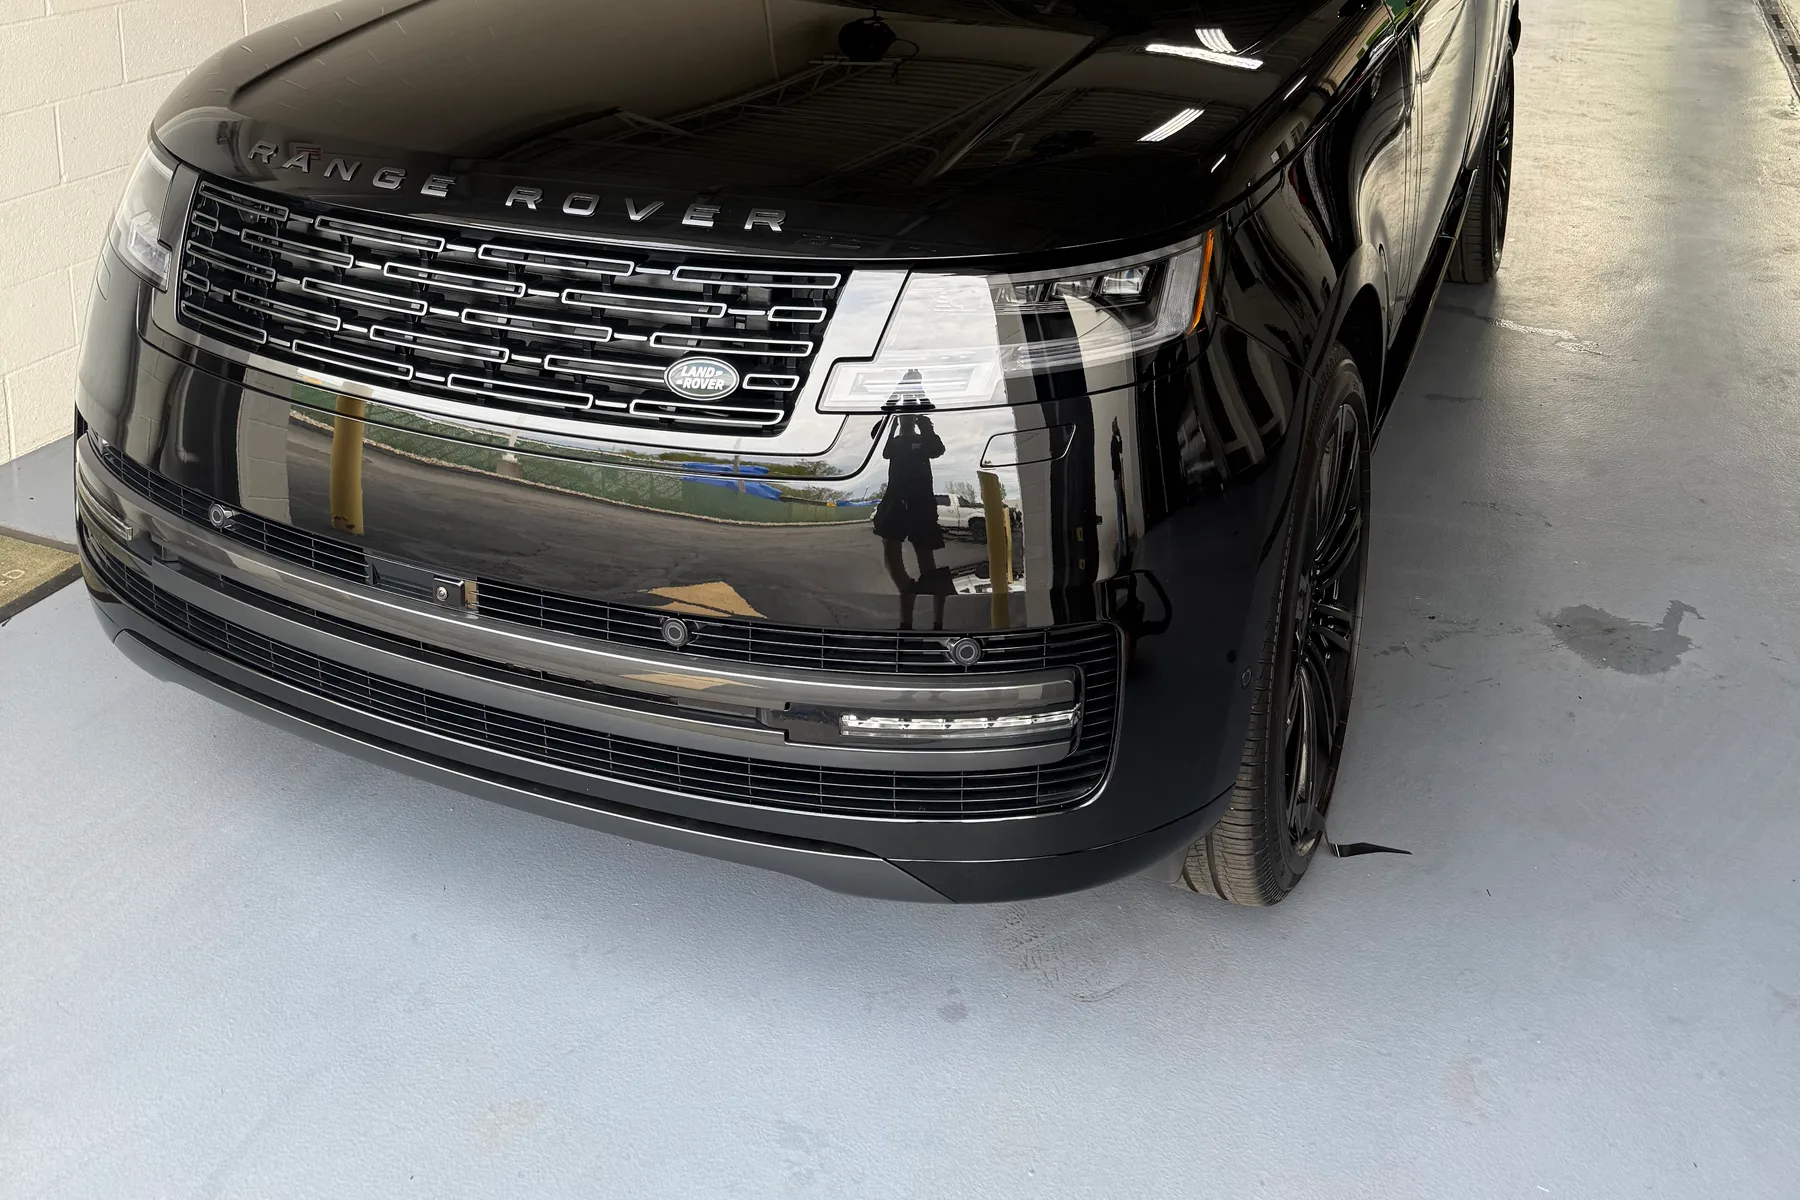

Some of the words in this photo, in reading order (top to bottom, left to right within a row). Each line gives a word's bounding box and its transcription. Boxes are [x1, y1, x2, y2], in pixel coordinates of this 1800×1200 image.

[247, 140, 457, 198] RANGE
[504, 185, 787, 232] ROVER
[681, 365, 715, 378] LAND
[682, 377, 725, 390] ROVER
